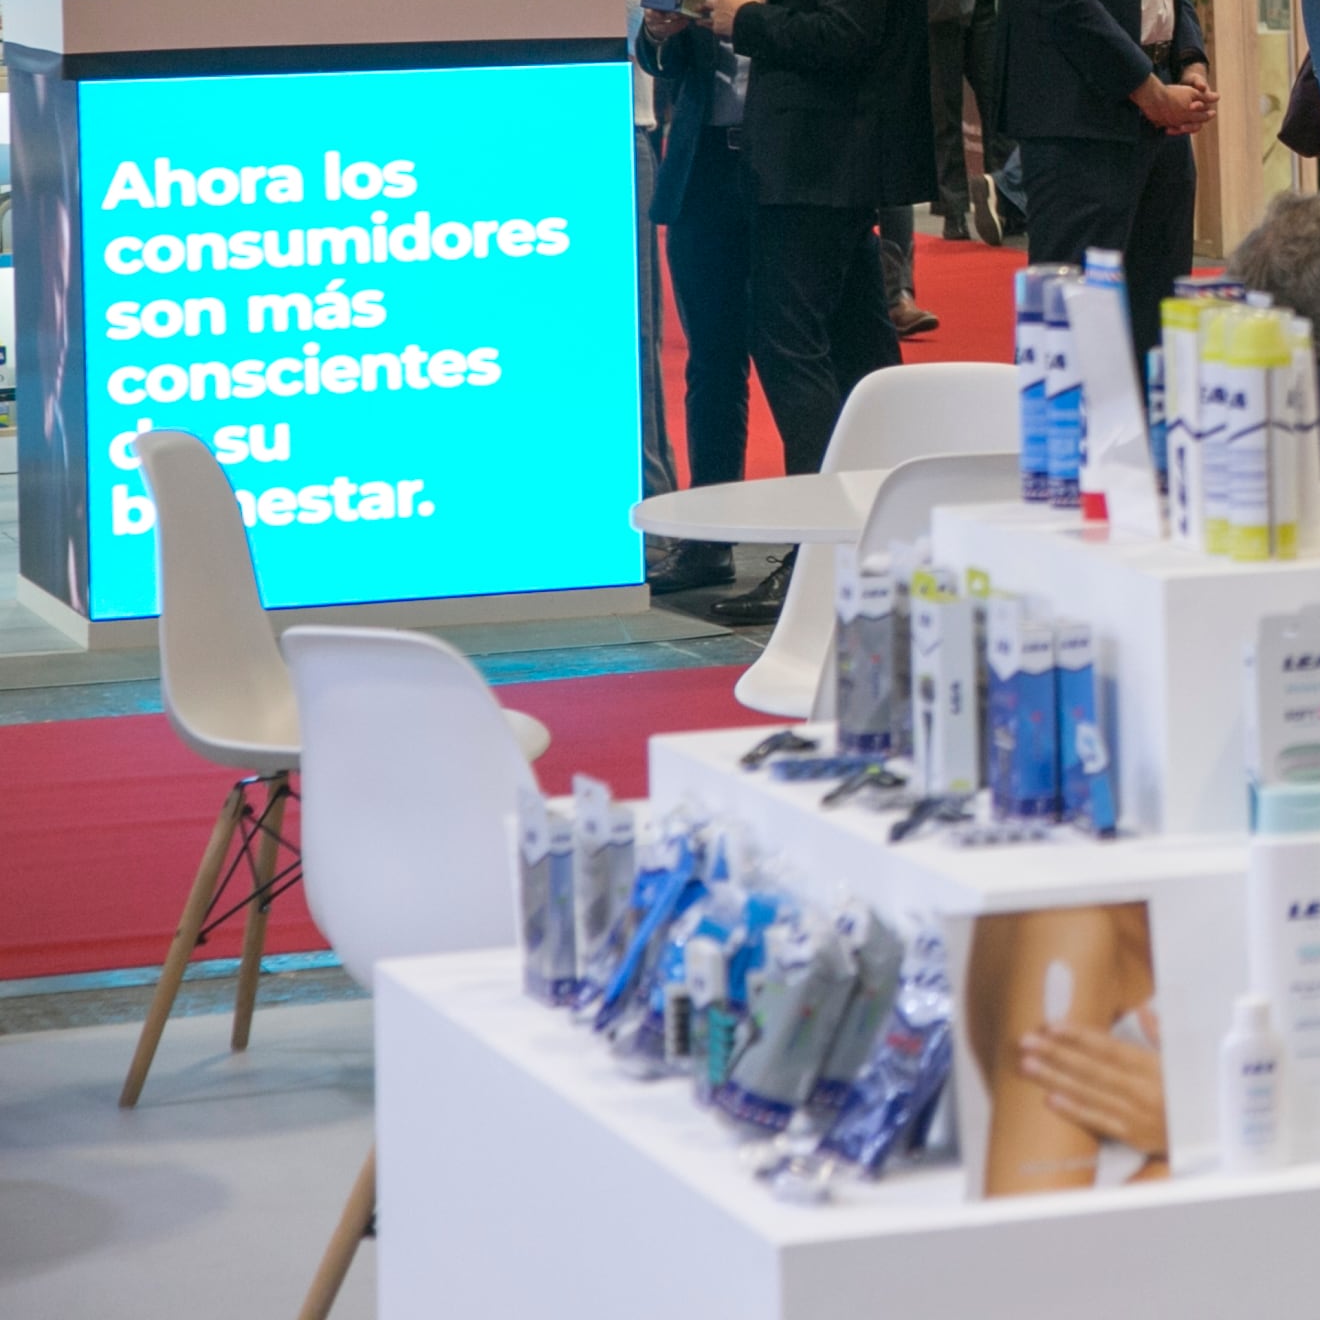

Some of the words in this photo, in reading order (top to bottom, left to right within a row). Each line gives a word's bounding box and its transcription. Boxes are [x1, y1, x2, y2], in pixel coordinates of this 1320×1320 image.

[101, 157, 304, 211] Ahora
[323, 150, 418, 202] los
[103, 209, 571, 276] consumidores
[105, 294, 227, 341] son
[247, 278, 387, 333] más
[106, 341, 502, 406] conscientes
[213, 422, 291, 465] su
